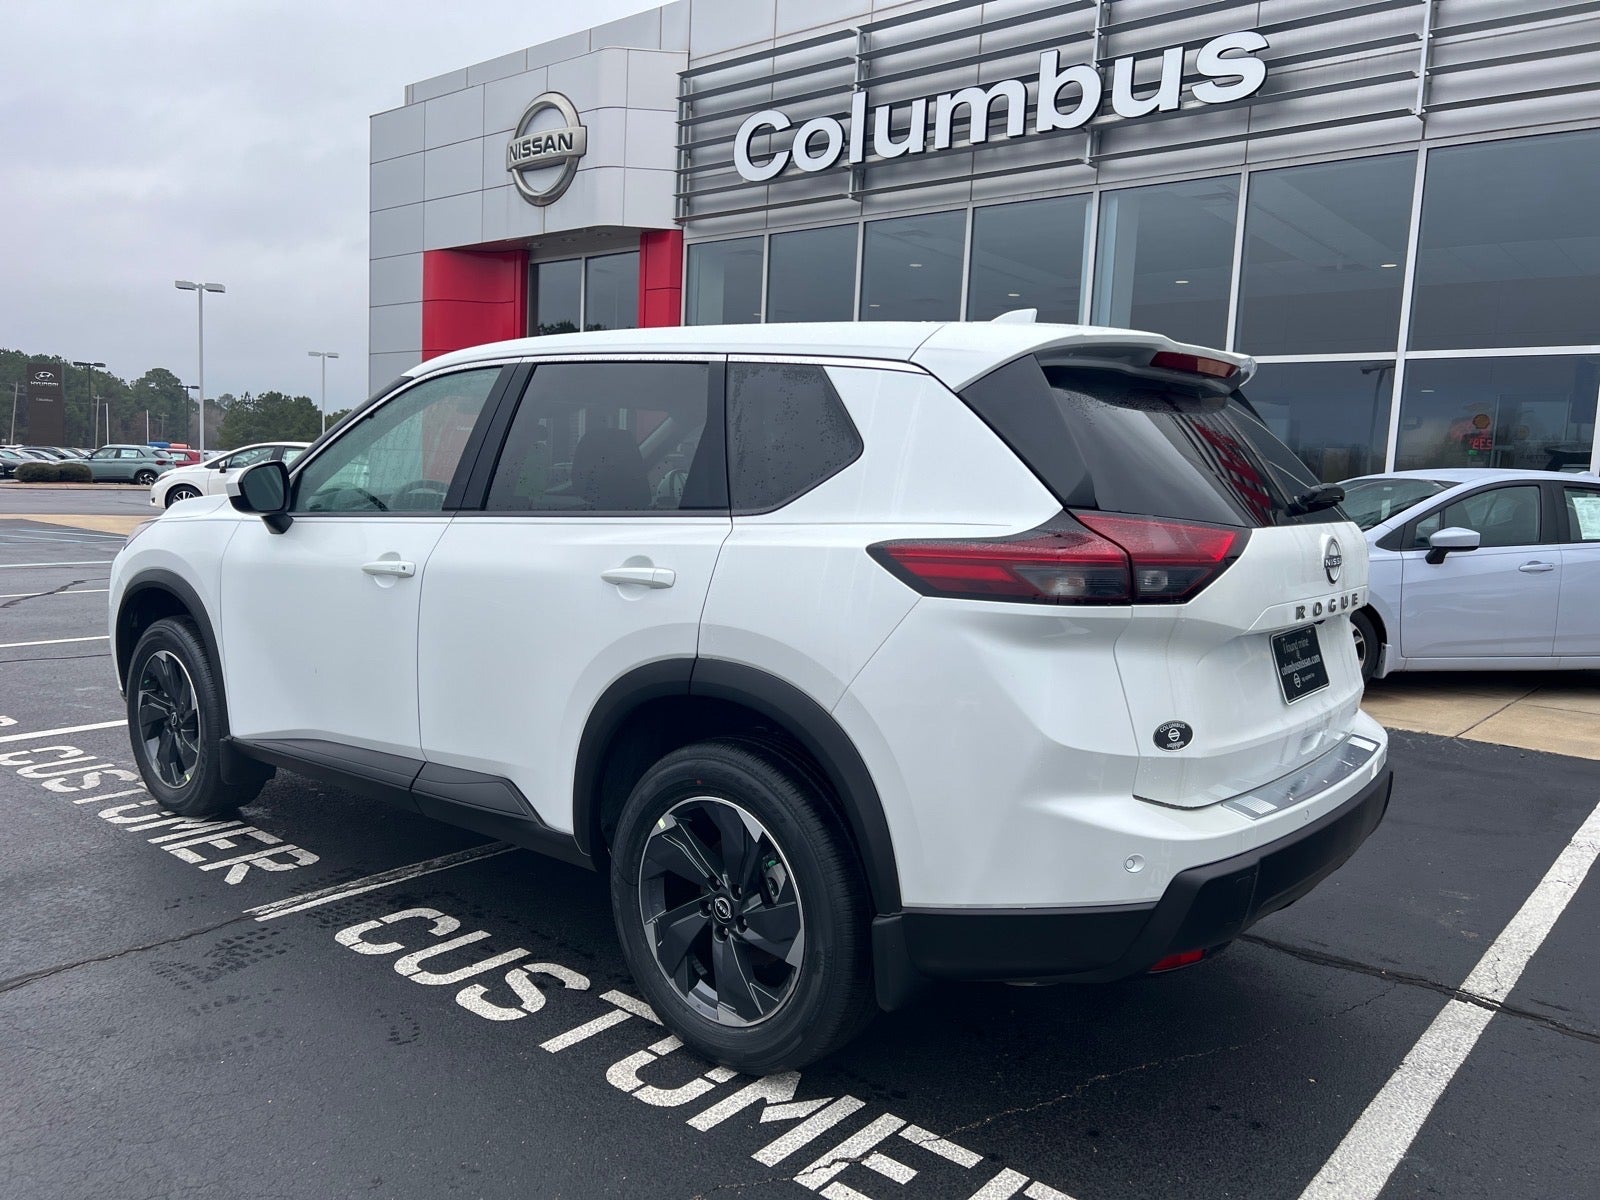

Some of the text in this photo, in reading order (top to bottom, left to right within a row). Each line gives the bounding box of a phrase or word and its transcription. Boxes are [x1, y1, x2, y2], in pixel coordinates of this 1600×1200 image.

[733, 31, 1270, 182] Columbus
[509, 132, 573, 162] NISSAN
[1325, 557, 1342, 567] NISS
[1296, 593, 1358, 620] ROGUE
[1160, 722, 1185, 733] COLUMBUS
[0, 745, 320, 885] CUSTOMER
[334, 907, 1078, 1200] CUSTOME
